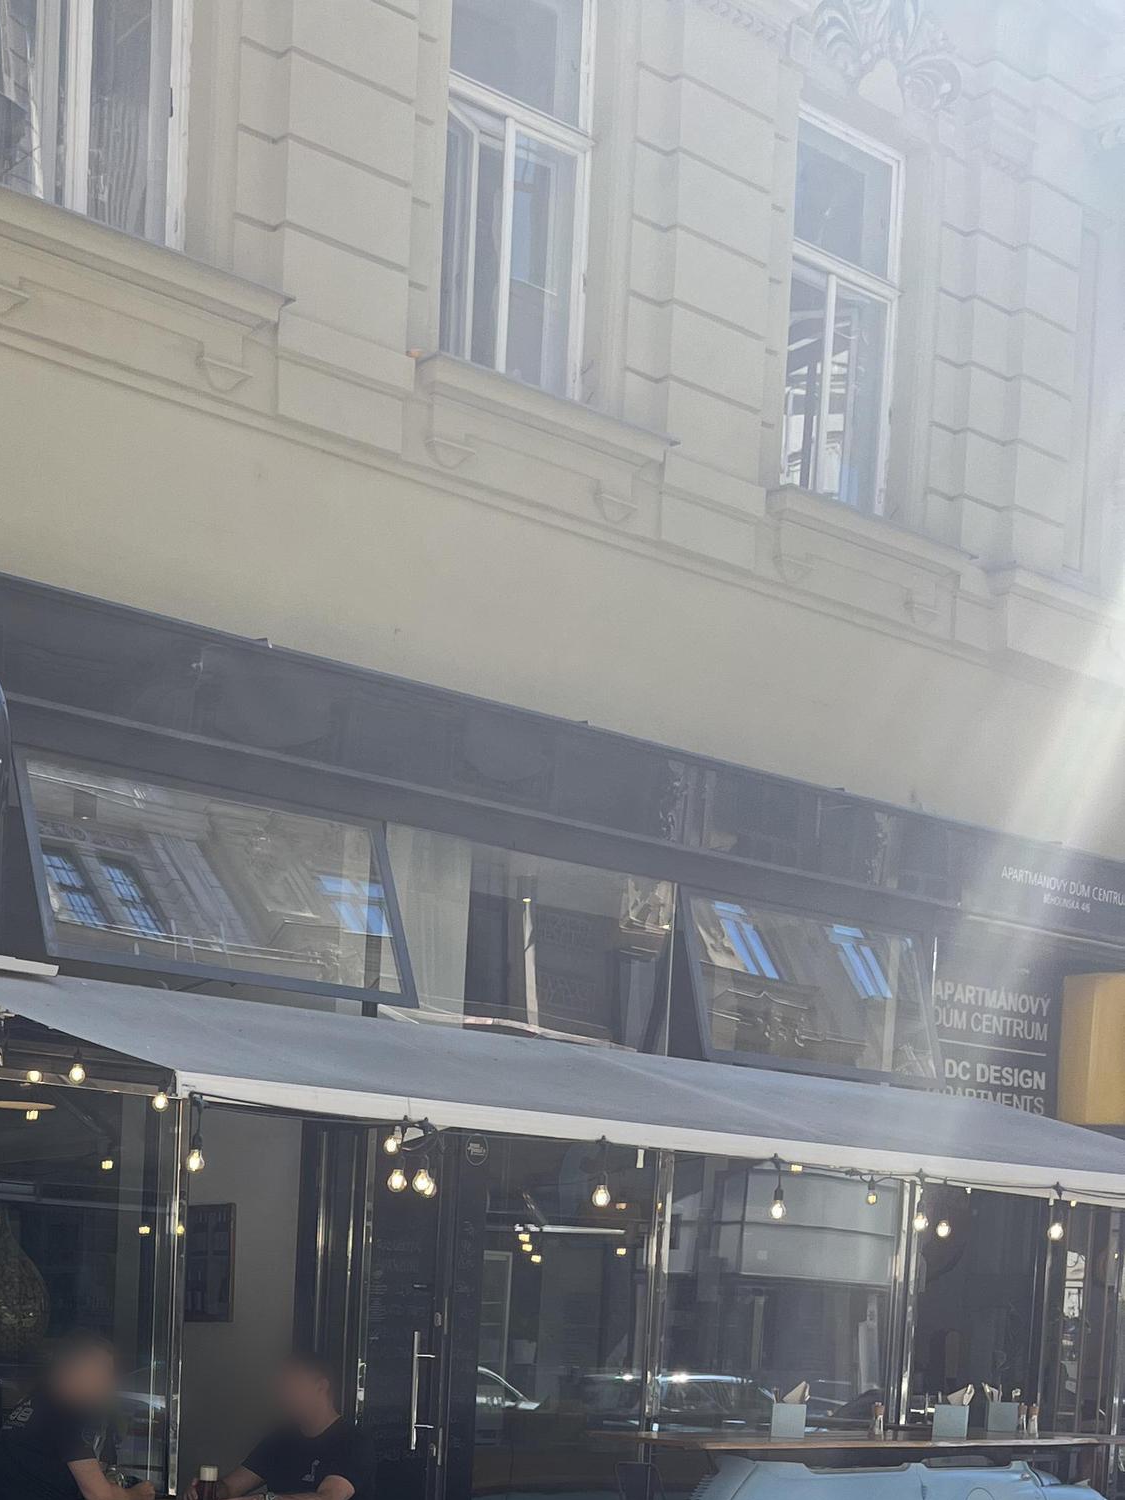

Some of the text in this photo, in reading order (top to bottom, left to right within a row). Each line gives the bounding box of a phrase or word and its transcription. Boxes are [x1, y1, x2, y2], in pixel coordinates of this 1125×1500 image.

[933, 978, 1051, 1017] APARTMÁNOVÝ
[970, 1012, 1048, 1042] CENTRUM
[944, 1058, 1046, 1090] DC DESIGN
